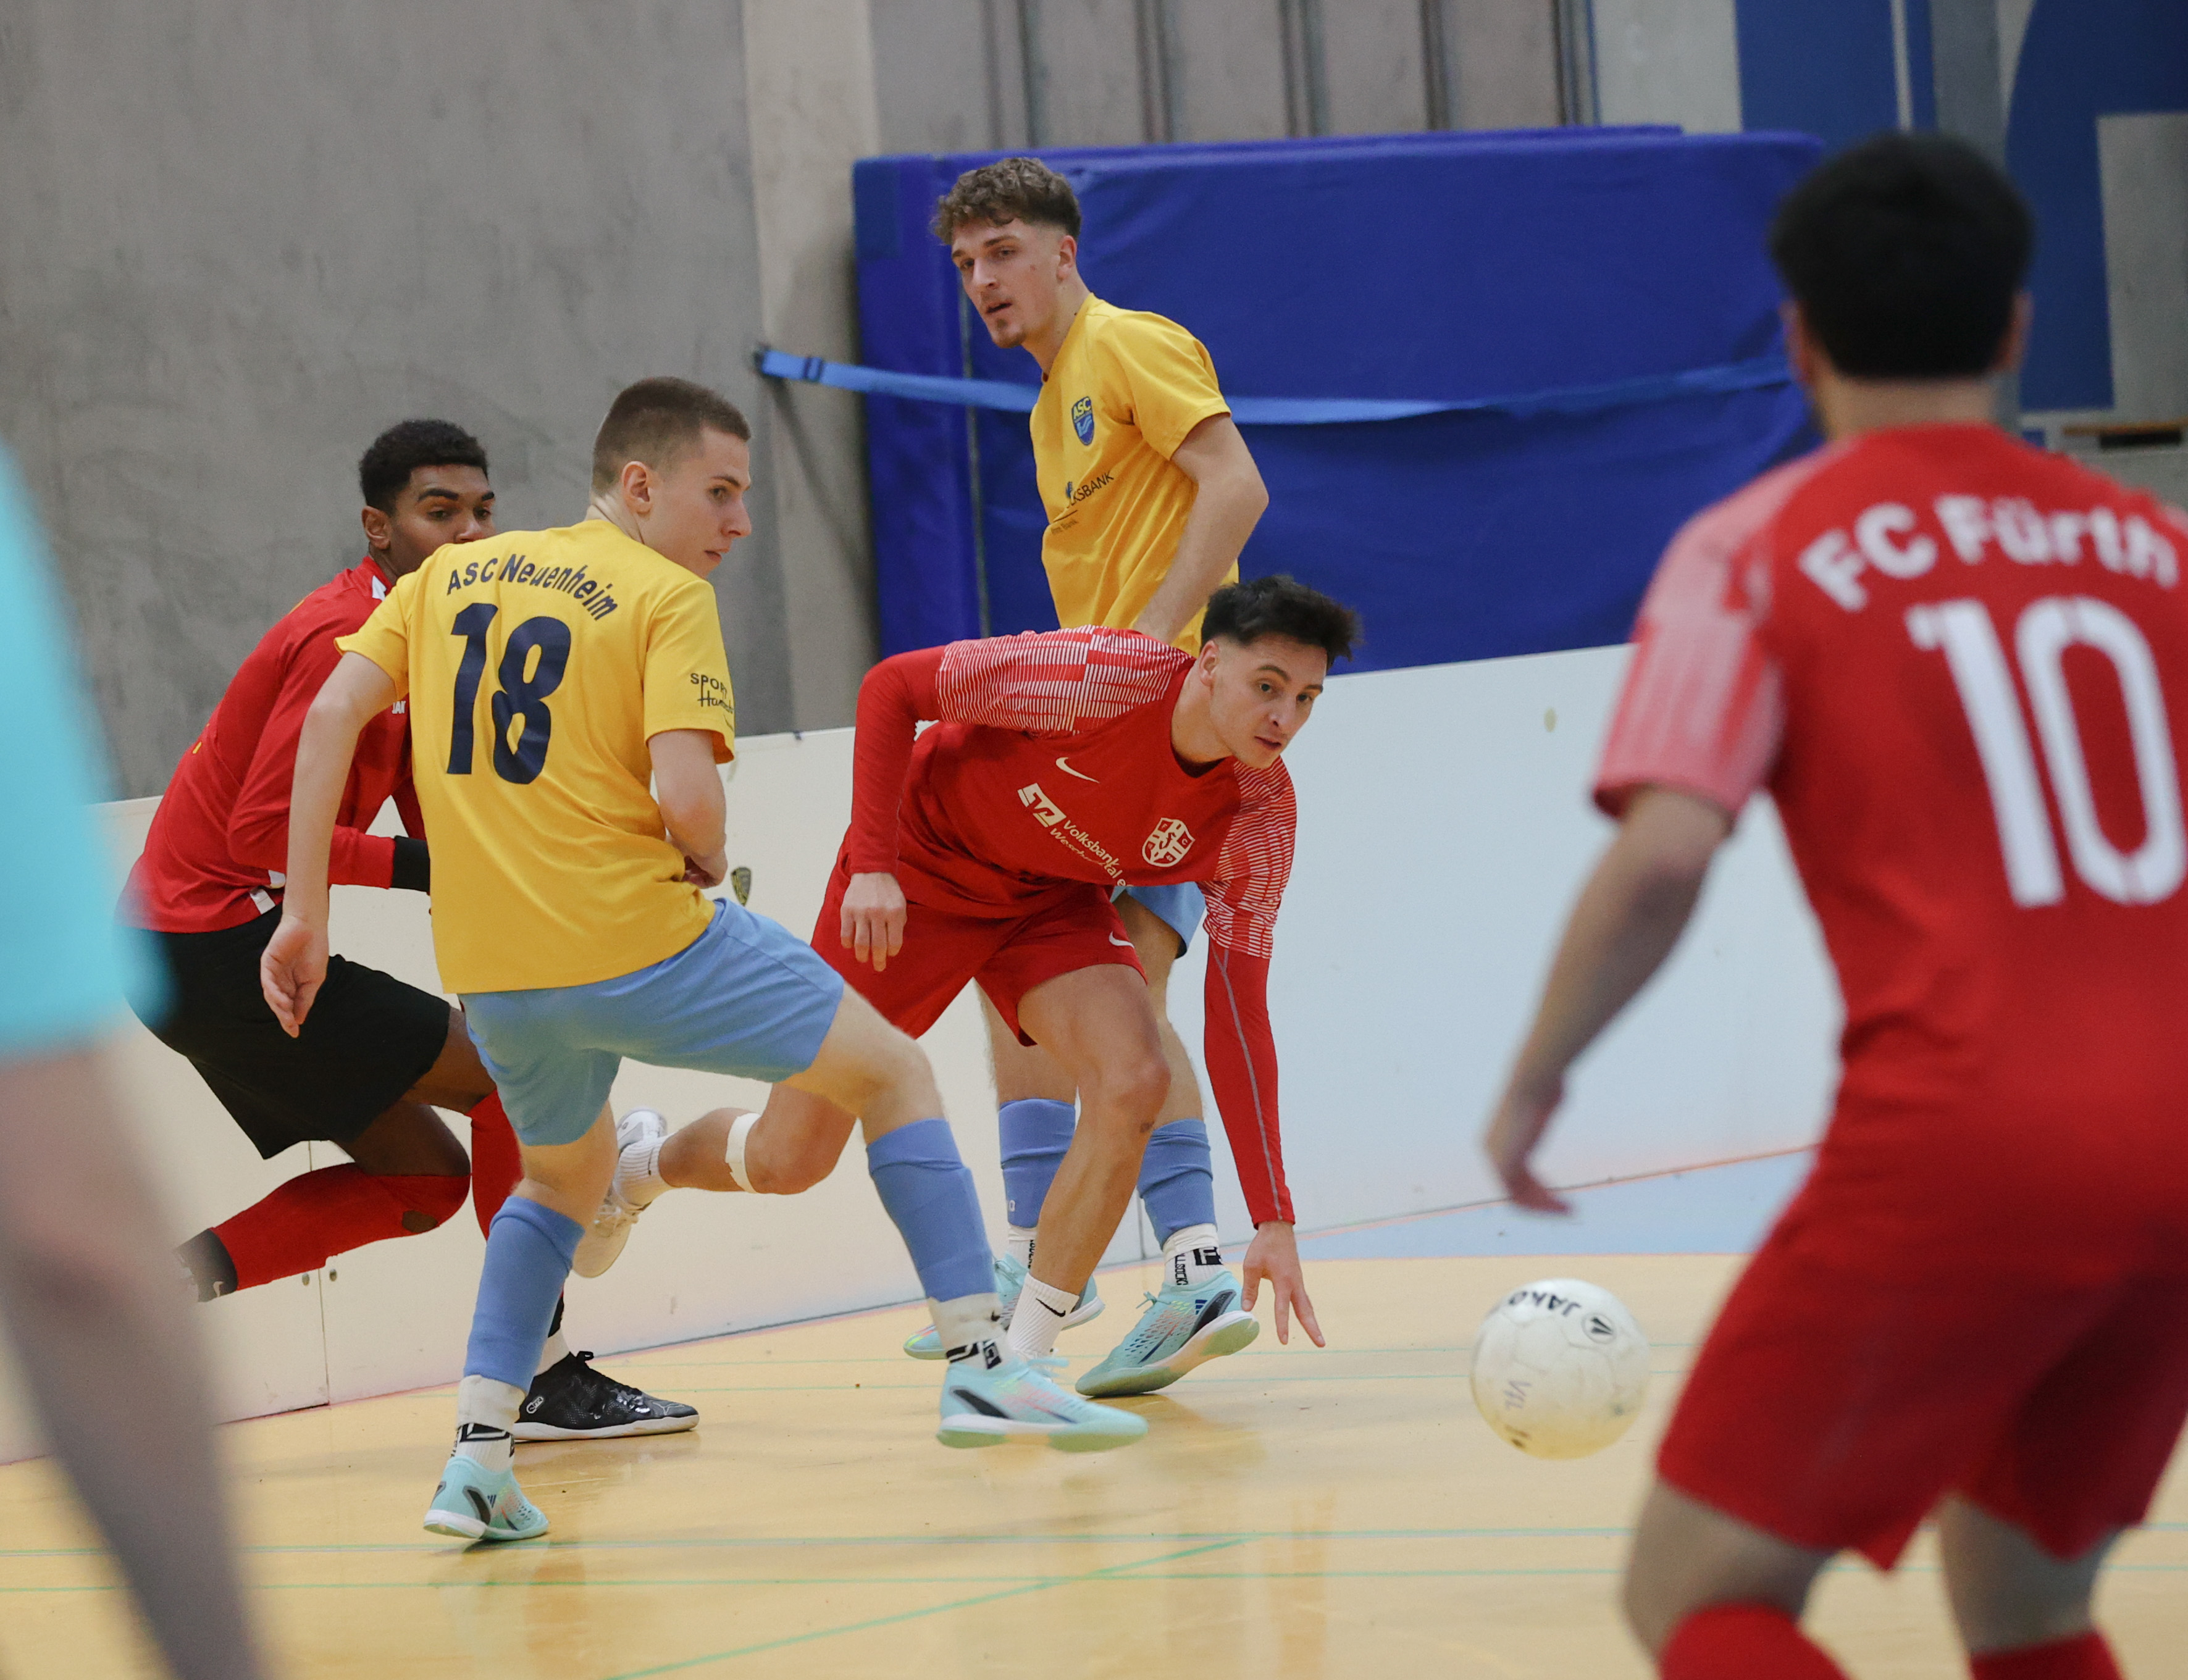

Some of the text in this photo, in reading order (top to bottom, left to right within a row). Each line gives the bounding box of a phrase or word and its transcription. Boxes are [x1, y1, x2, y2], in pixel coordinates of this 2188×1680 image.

[1073, 397, 1091, 420] ASC
[446, 554, 618, 621] ASC Neuenheim
[1799, 493, 2181, 612] FC Fürth
[446, 603, 571, 785] 18
[1904, 594, 2188, 908] 10
[1063, 820, 1120, 866] Volksbank
